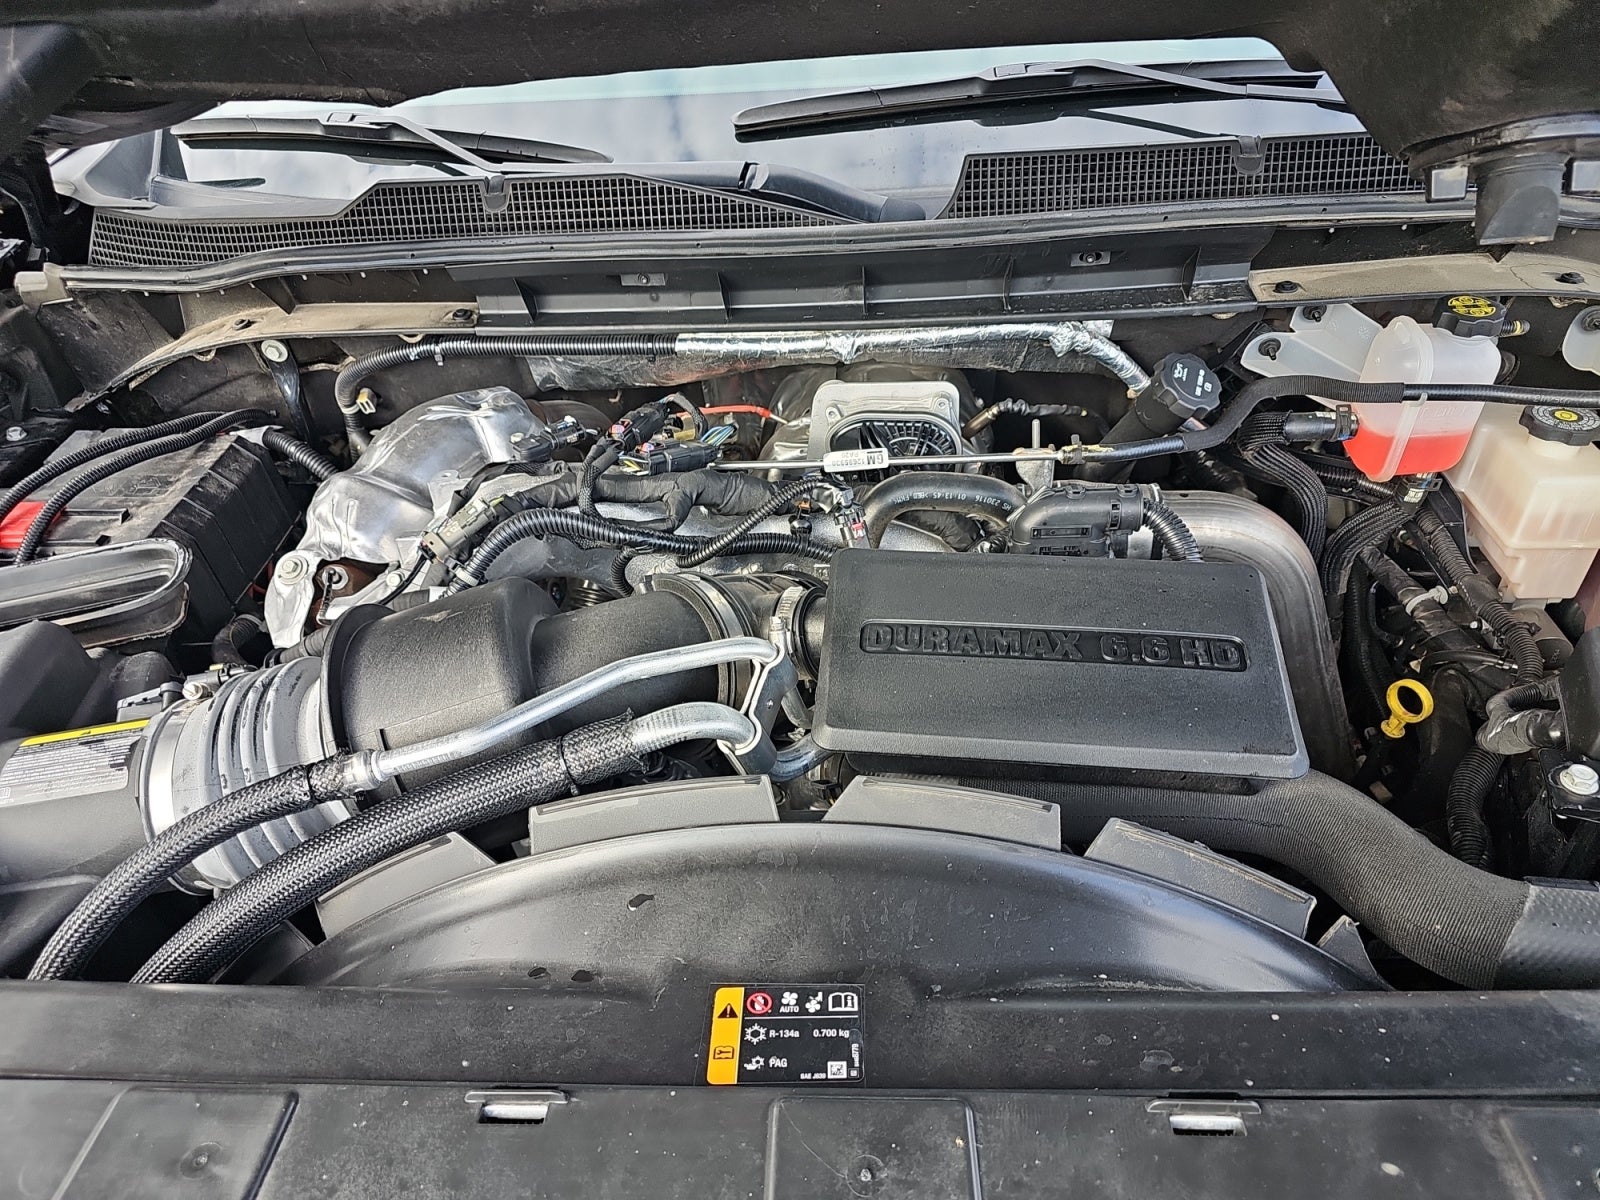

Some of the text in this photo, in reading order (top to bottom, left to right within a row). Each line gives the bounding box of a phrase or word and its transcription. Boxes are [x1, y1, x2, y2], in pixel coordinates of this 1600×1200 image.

[866, 453, 884, 465] GM
[975, 494, 1001, 507] 230116
[1001, 502, 1012, 512] HS
[864, 624, 1243, 668] DURAMAX 6.6 HD
[779, 1005, 800, 1013] AUTO
[769, 1028, 850, 1039] R-134a 0.700 kg
[769, 1058, 788, 1068] PAG
